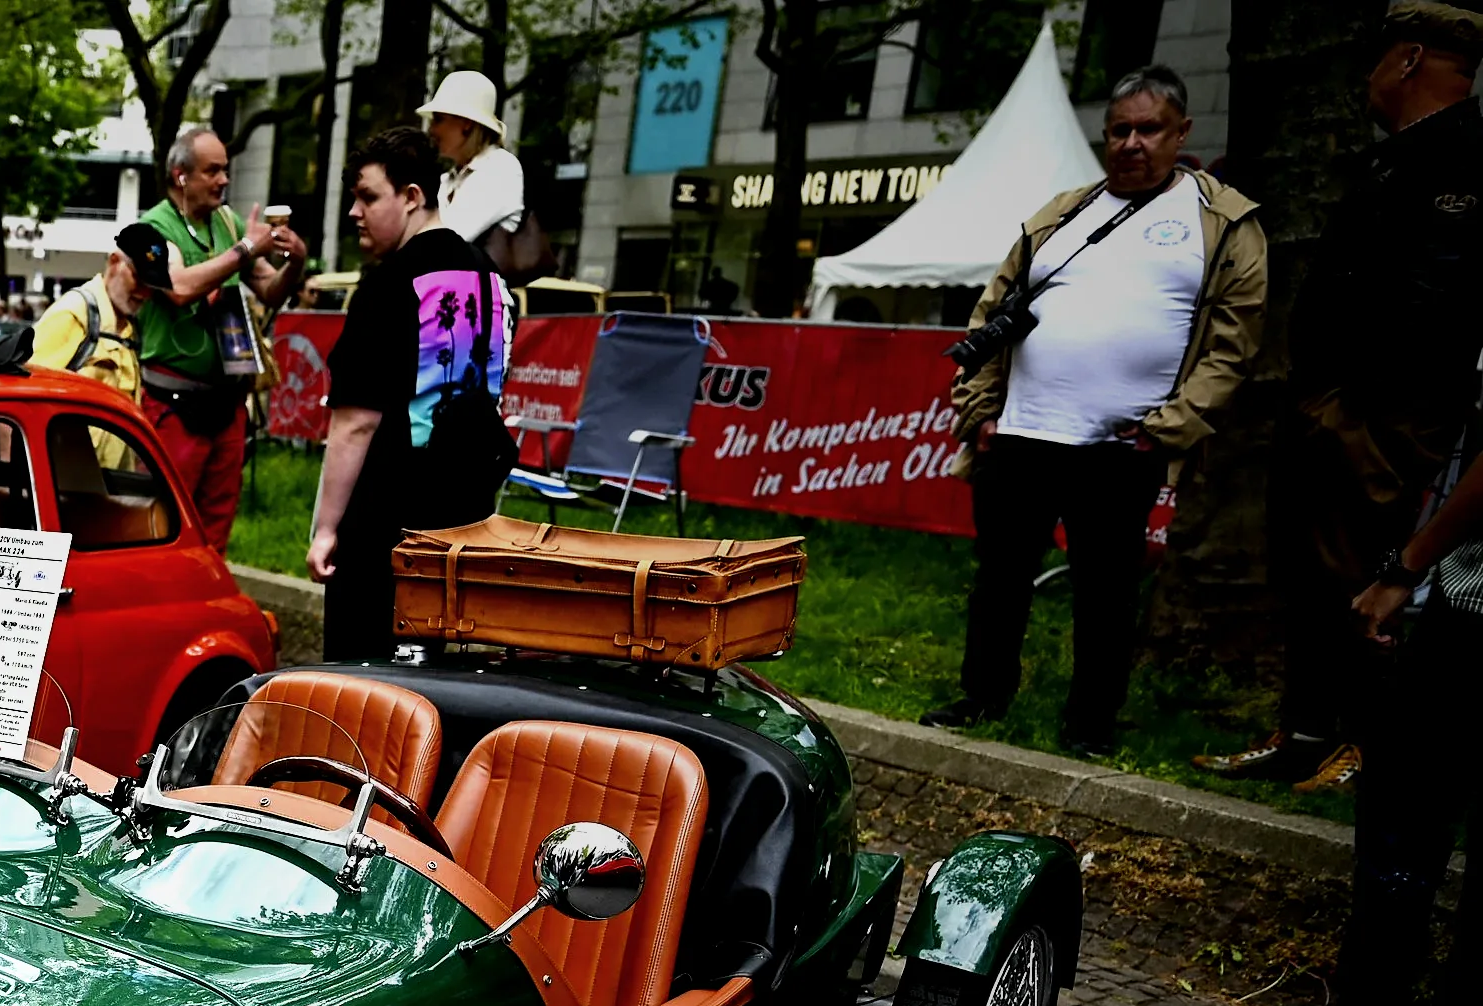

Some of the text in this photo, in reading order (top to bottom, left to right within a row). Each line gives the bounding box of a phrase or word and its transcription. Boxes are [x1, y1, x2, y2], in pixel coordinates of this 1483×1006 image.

[653, 79, 702, 116] 220
[731, 173, 828, 208] SHANG
[829, 169, 884, 205] NEW
[714, 423, 759, 460] Ihr
[753, 466, 784, 497] in
[791, 452, 891, 494] Sachen
